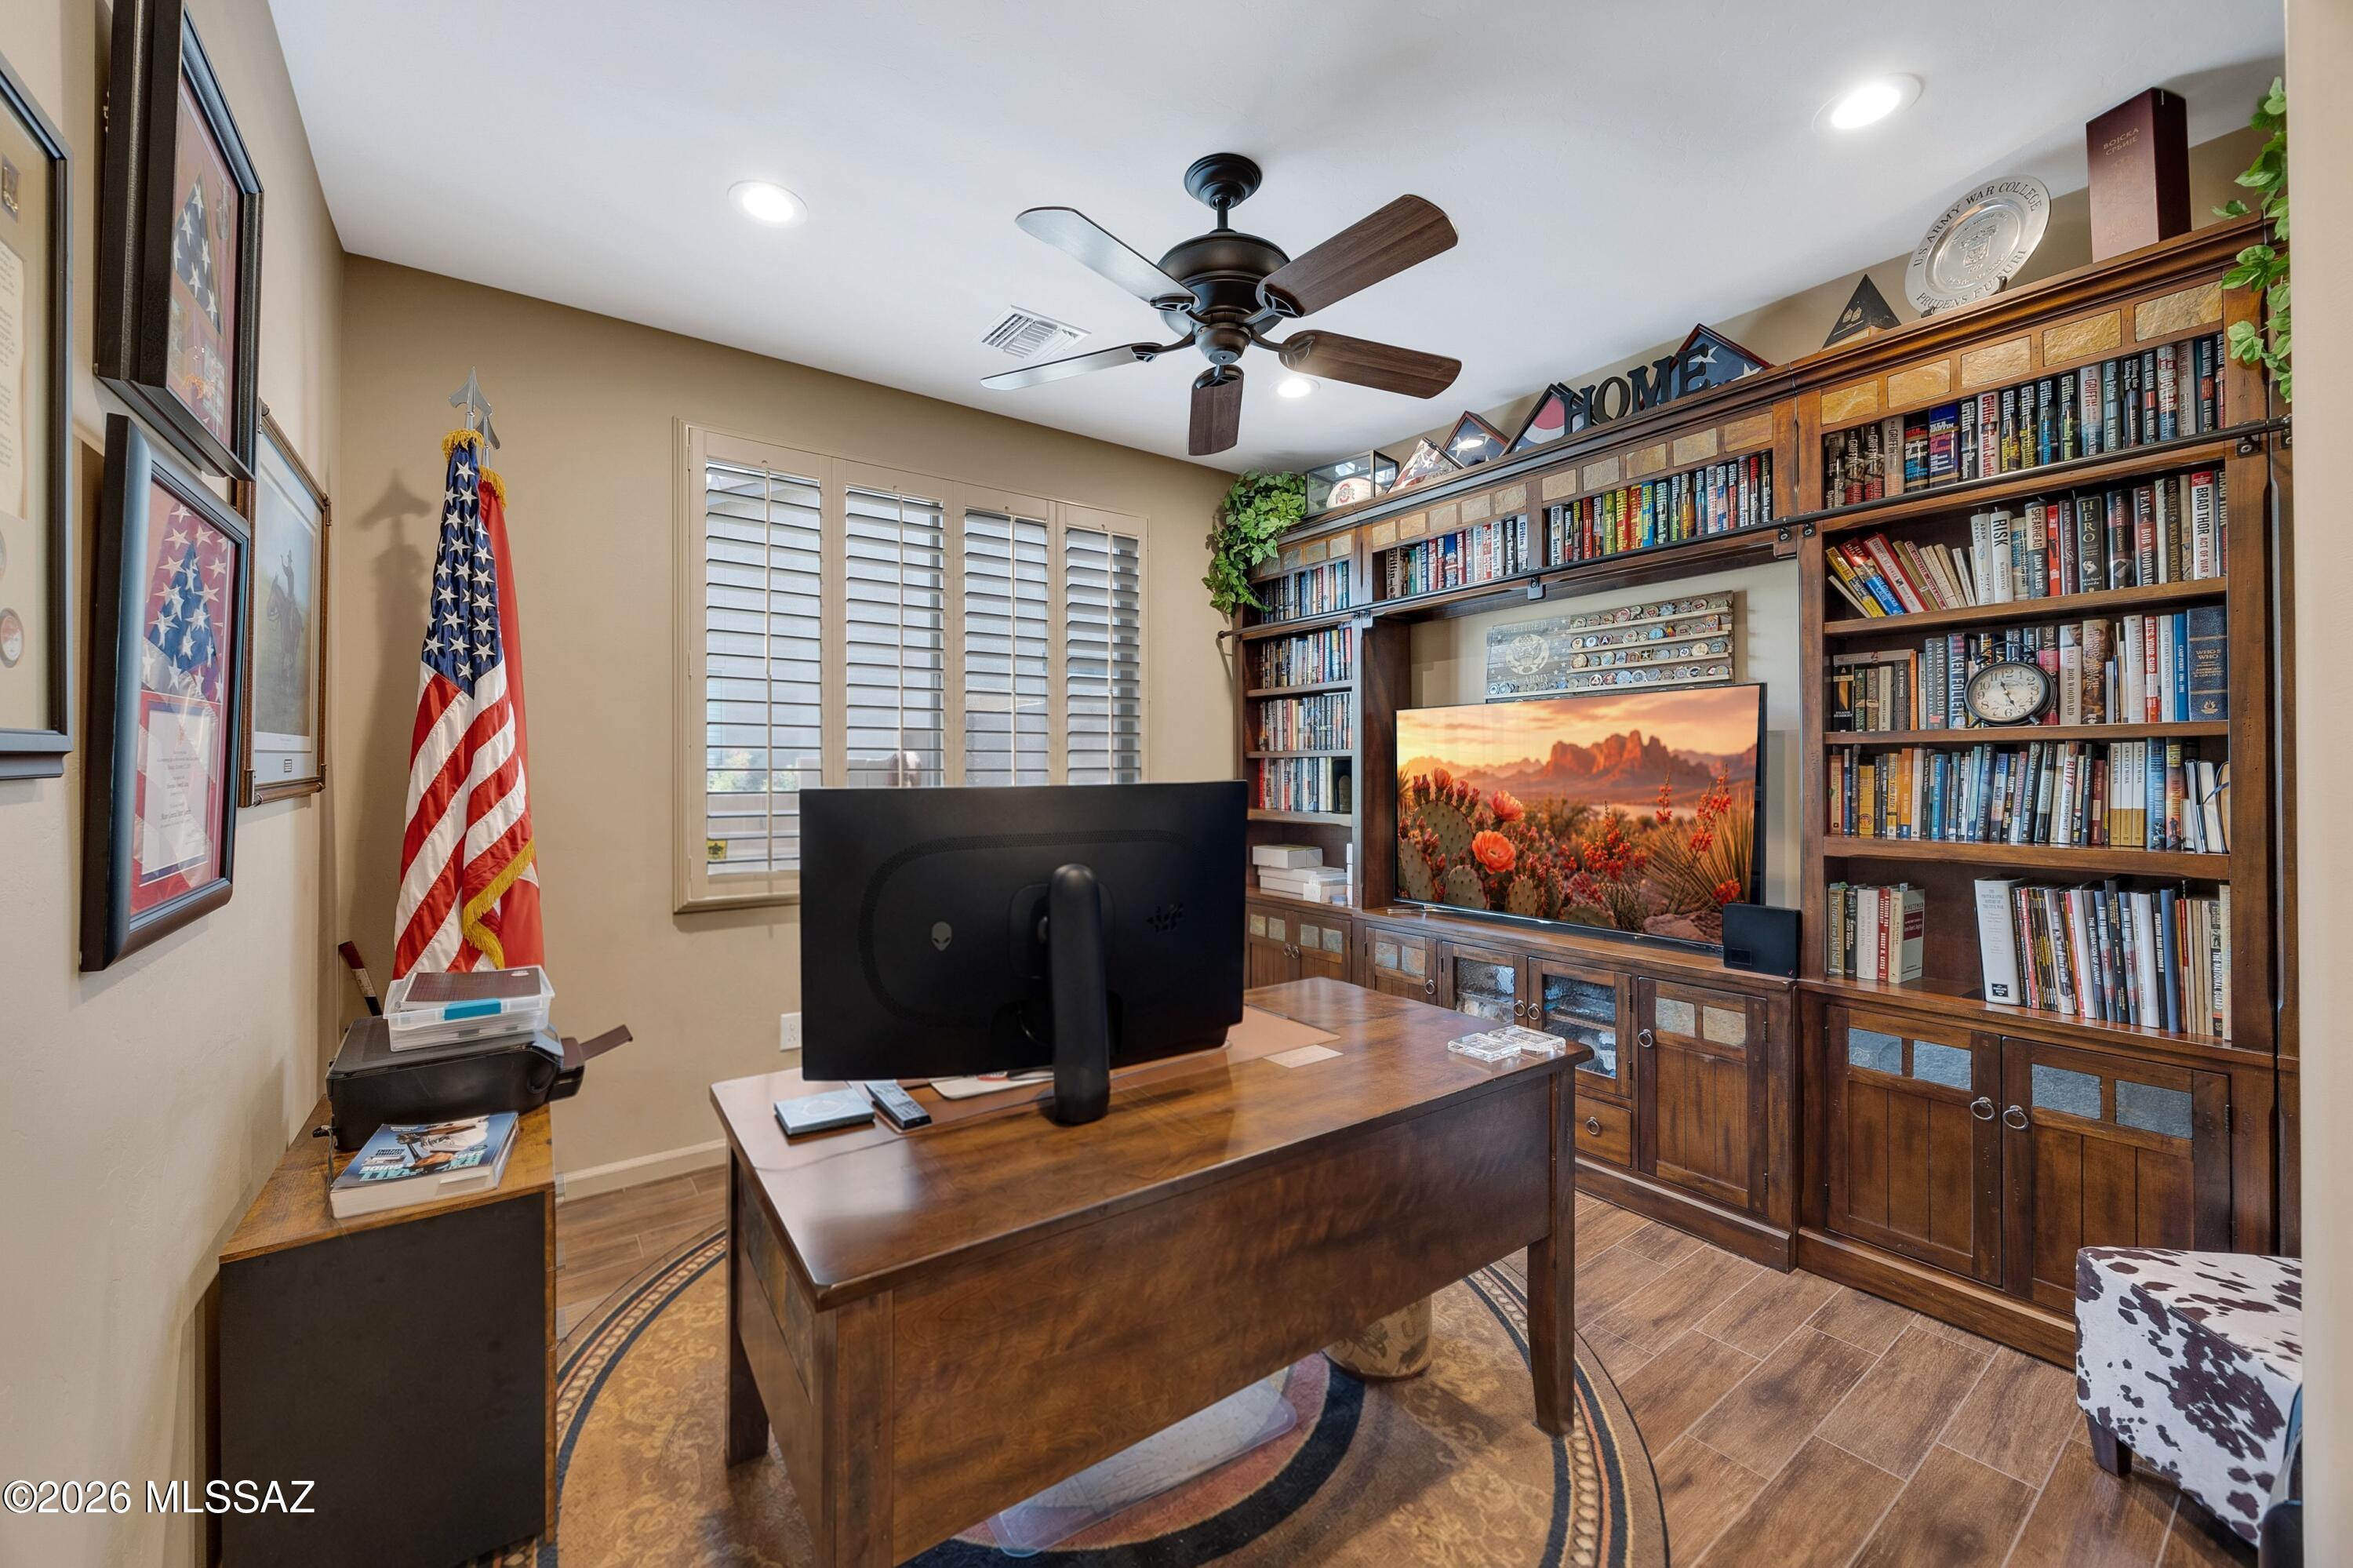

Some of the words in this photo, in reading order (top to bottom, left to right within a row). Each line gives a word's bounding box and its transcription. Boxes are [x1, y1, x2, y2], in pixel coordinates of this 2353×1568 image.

[1926, 204, 1962, 244] ARMY
[1966, 185, 1995, 206] WAR
[1998, 181, 2042, 213] COLLEGE
[1561, 342, 1711, 435] HOME
[2021, 386, 2035, 417] Griffin
[2040, 380, 2052, 407] Griffin
[2061, 375, 2074, 402] Griffin
[2085, 379, 2097, 406] GRIFFIN
[1962, 402, 1975, 432] Griffin
[2002, 391, 2014, 420] Griffin
[1848, 439, 1858, 464] GRIFFIN
[1868, 435, 1878, 460] GRIFFIN
[1889, 429, 1898, 453] GRIFFIN
[1617, 490, 1627, 522] Griffin
[1657, 482, 1667, 511] Griffin
[2140, 490, 2150, 515] FEAR
[2197, 487, 2209, 511] BRAD
[1993, 519, 2009, 547] RISK
[2031, 508, 2042, 548] SPEARHEAD
[2082, 502, 2096, 542] HERO
[2198, 511, 2209, 535] THOR
[2141, 529, 2151, 544] BOB
[2035, 572, 2043, 590] MAKOS
[1936, 643, 1944, 682] AMERICAN
[1951, 656, 1964, 674] KEN
[2002, 668, 2013, 678] 12
[1951, 678, 1964, 717] FOLLETT
[2064, 761, 2075, 786] BLITZ
